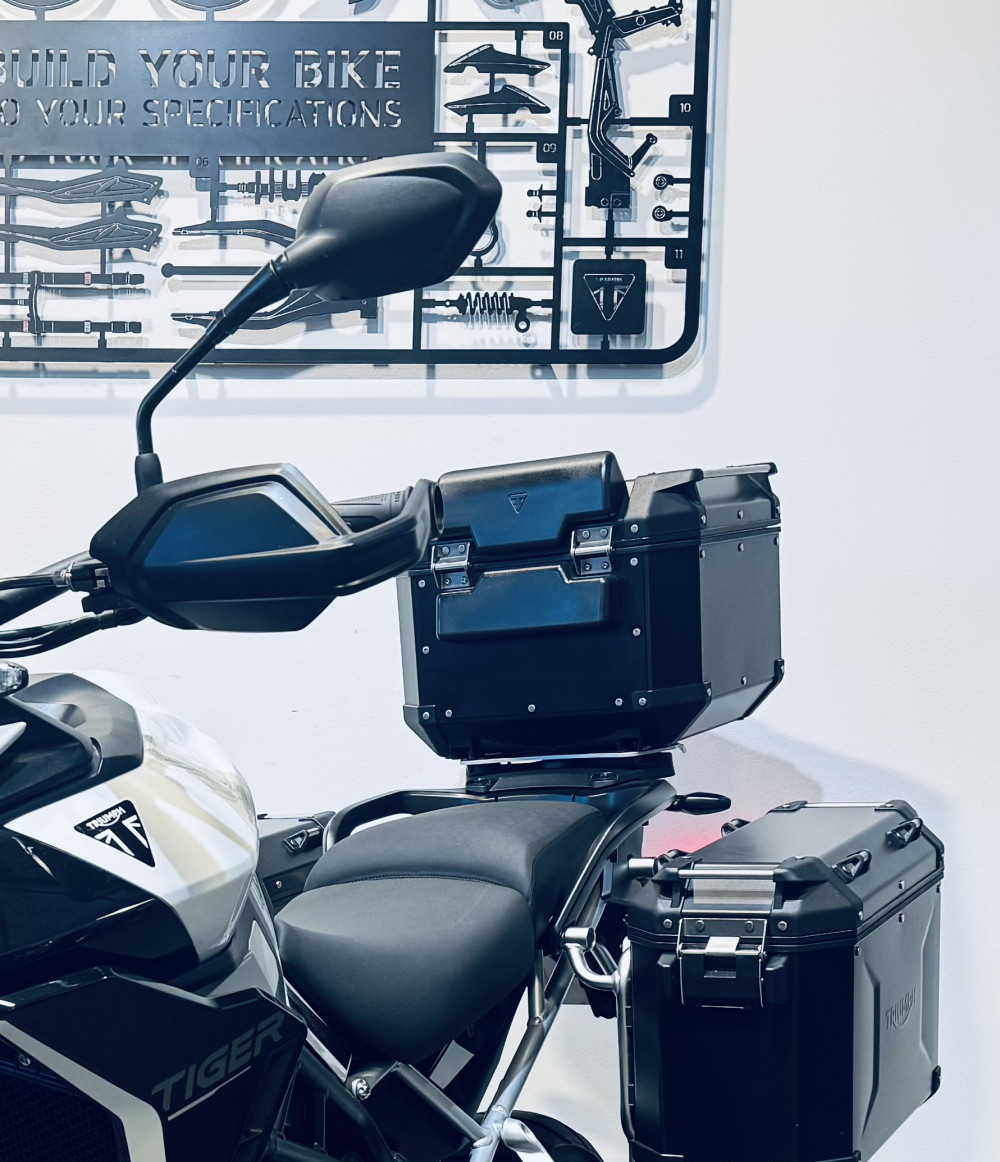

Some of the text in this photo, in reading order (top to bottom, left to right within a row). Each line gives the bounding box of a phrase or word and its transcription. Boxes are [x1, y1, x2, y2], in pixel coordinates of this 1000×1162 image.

[548, 30, 564, 41] 08
[138, 48, 270, 89] YOUR
[293, 49, 402, 89] BIKE
[679, 102, 692, 113] 10
[36, 98, 127, 127] YOUR
[142, 98, 403, 129] SPECIFICATIONS
[542, 143, 557, 153] 09
[195, 156, 209, 167] 06
[674, 248, 684, 259] 11
[85, 806, 127, 830] TRIUMPH
[150, 1010, 285, 1113] TIGER
